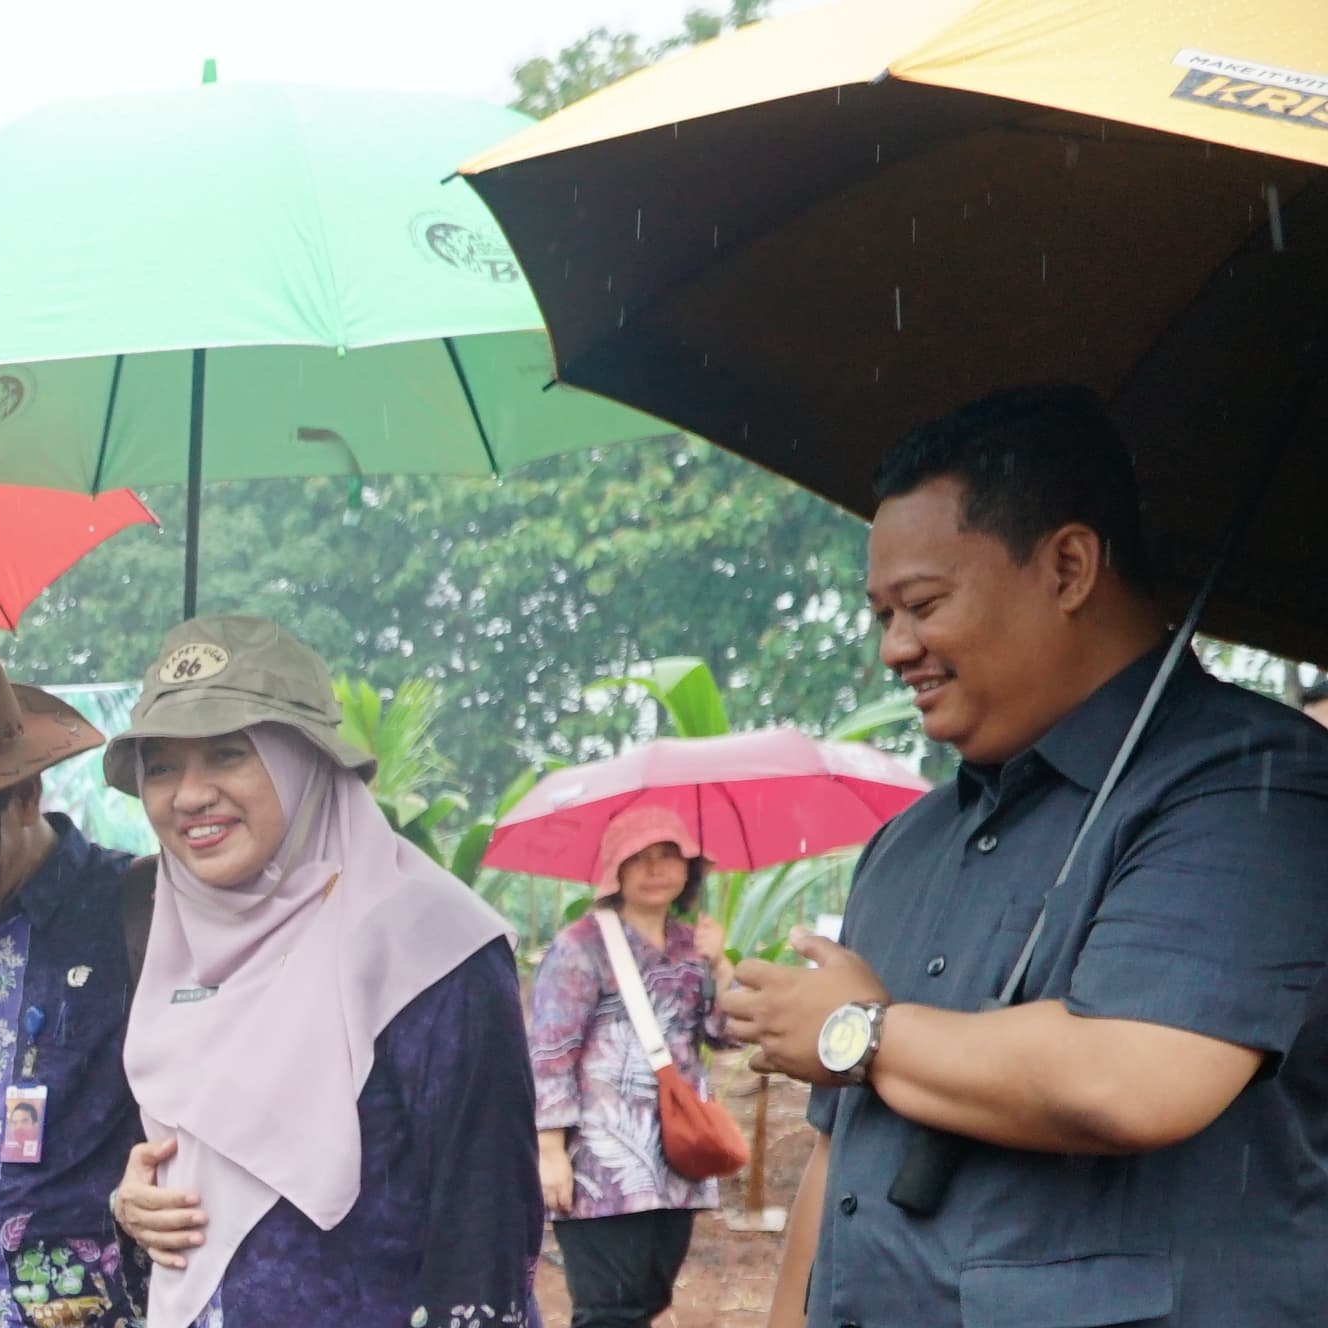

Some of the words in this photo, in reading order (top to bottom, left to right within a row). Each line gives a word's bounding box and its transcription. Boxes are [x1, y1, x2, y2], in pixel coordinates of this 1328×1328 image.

[1189, 55, 1256, 75] MAKE
[1259, 70, 1282, 80] IT
[173, 657, 202, 679] 86
